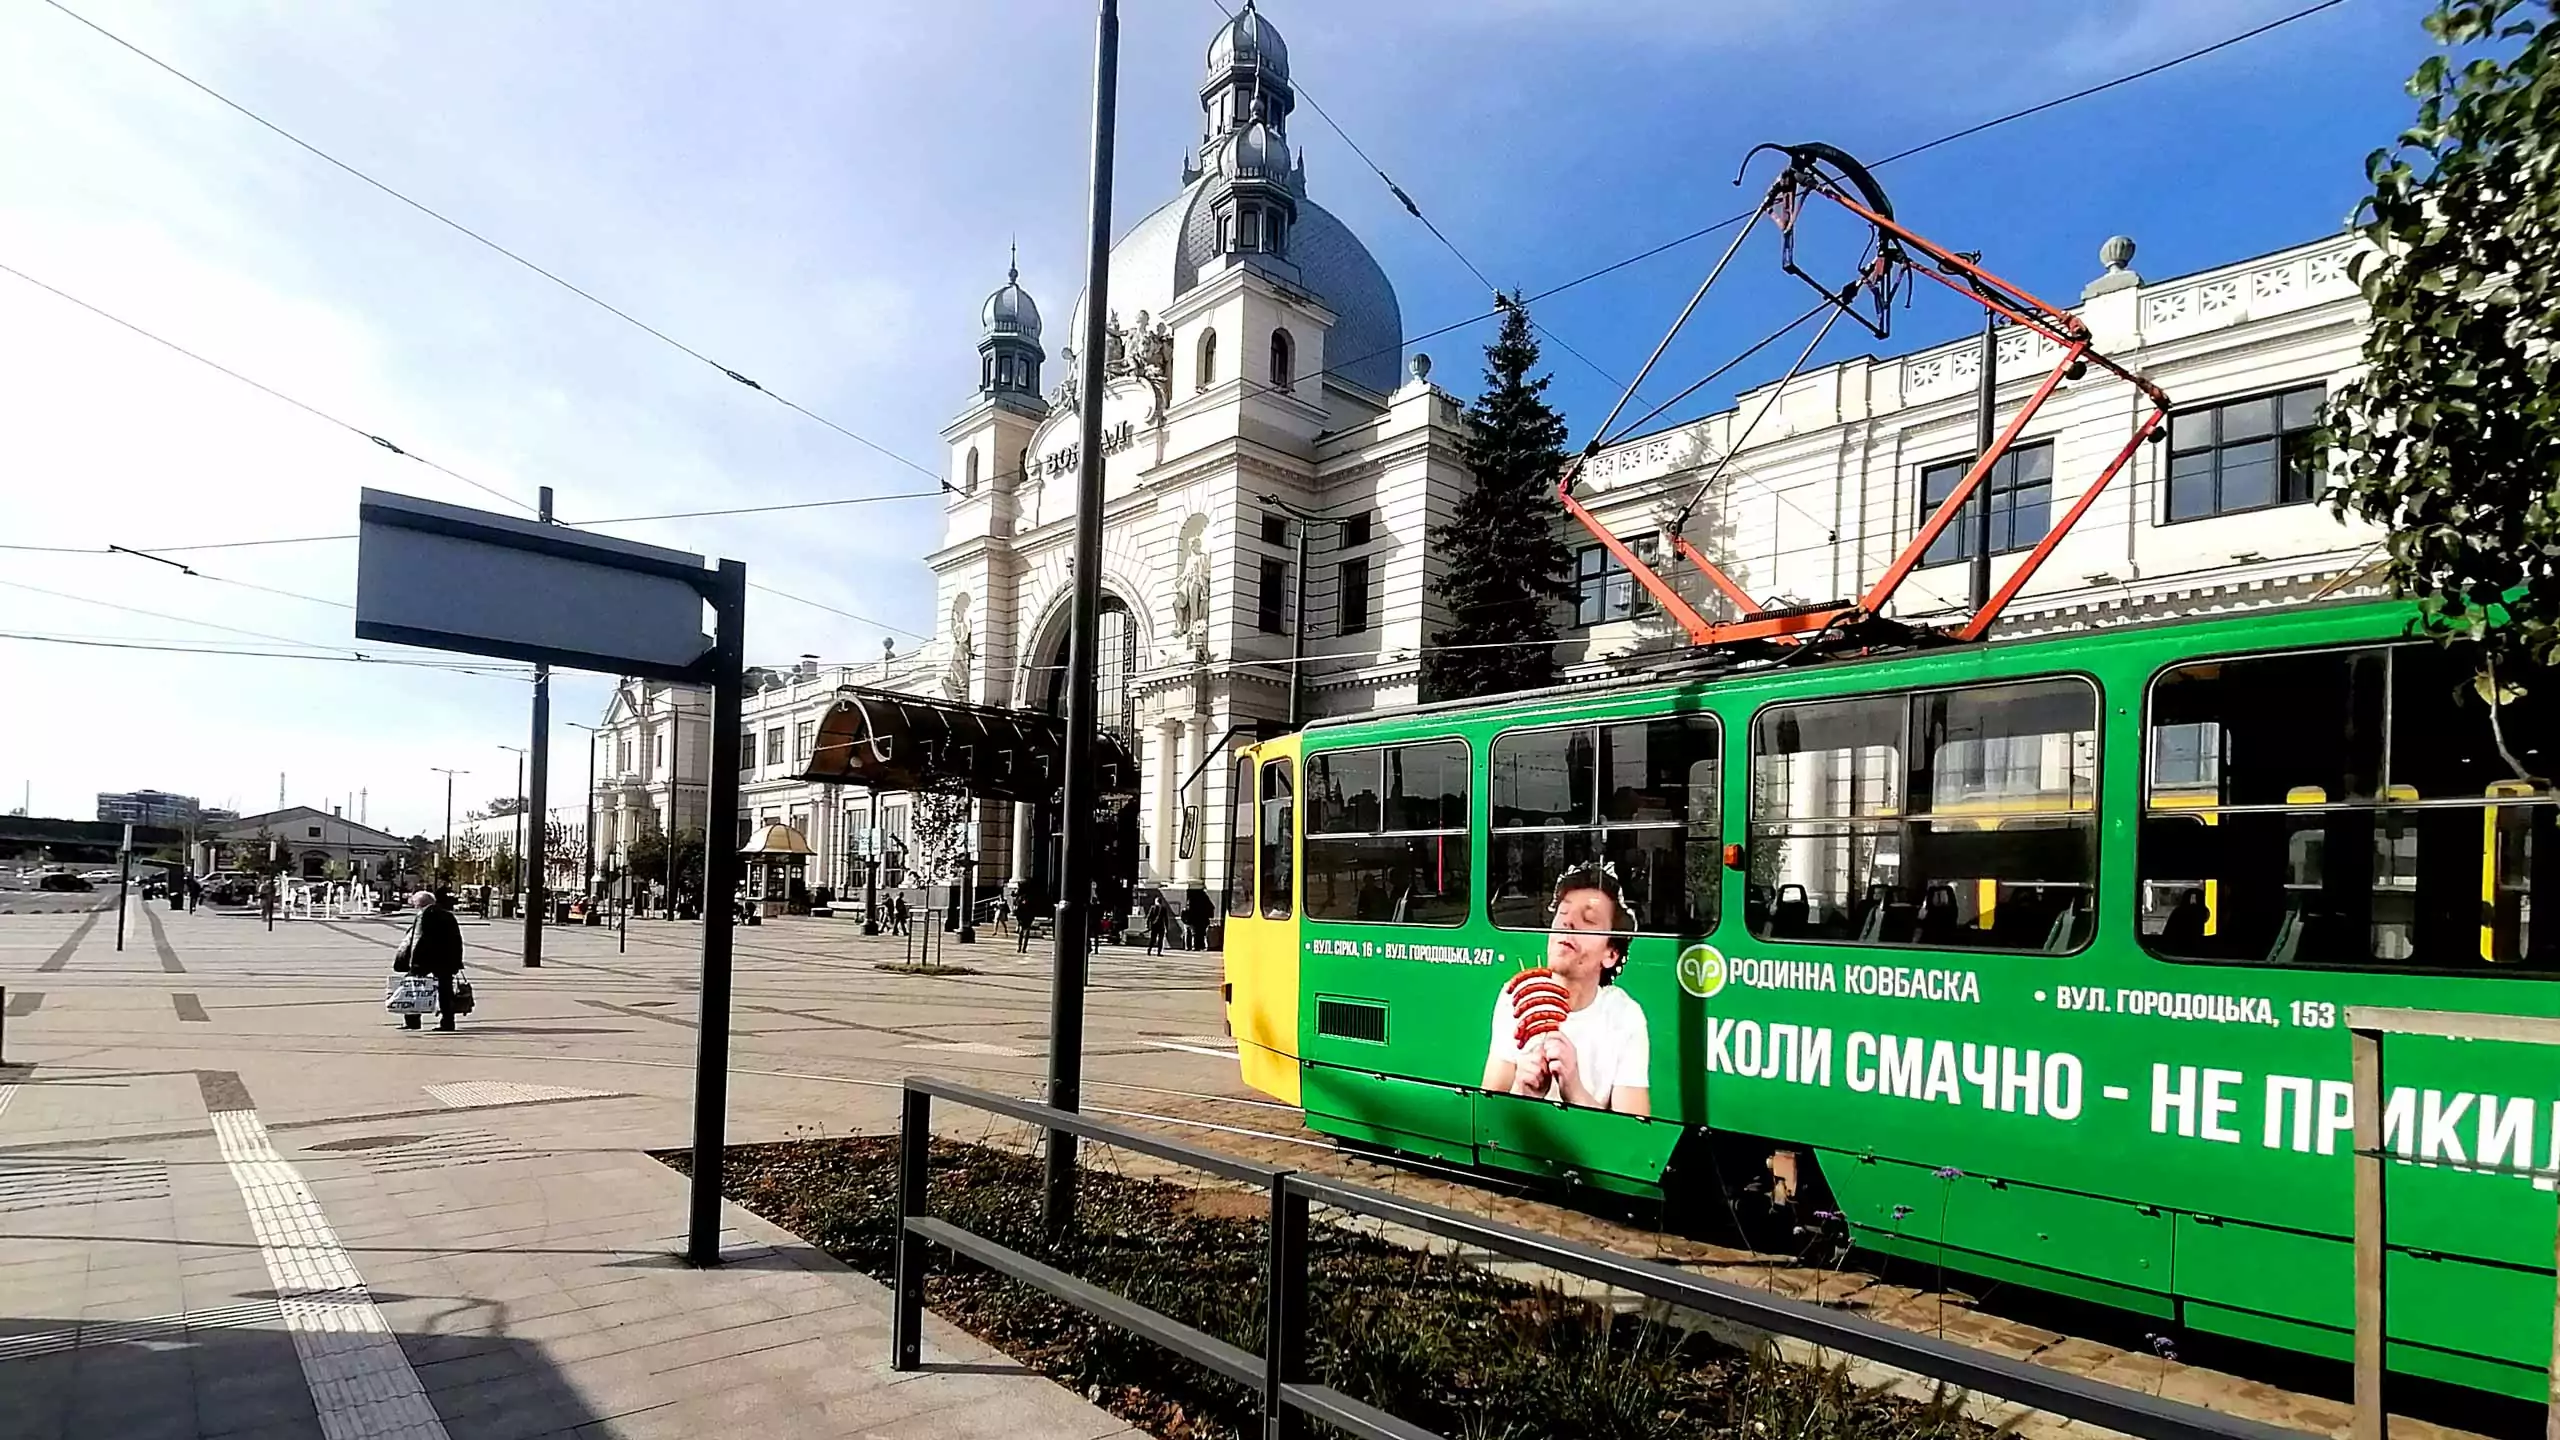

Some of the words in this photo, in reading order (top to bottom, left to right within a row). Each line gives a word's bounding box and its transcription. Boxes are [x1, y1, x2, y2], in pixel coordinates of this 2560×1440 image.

[1046, 420, 1129, 475] ВОАЛ
[1313, 939, 1333, 955] ВУЛ.
[1333, 940, 1360, 958] СІРКА,
[1362, 941, 1373, 957] 16
[1385, 943, 1408, 960] ВУЛ.
[1409, 944, 1472, 966] ГОРОДОЦЬКА,
[1473, 948, 1494, 965] 247
[1729, 957, 1836, 991] РОДИННА
[1844, 964, 1980, 1003] КОВБАСКА
[387, 1001, 415, 1009] CTION
[2057, 985, 2111, 1012] ВУЛ.
[2116, 989, 2280, 1027] ГОРОДОЦЬКА,
[2290, 1000, 2336, 1028] 153
[1706, 1016, 1832, 1087] КОЛИ
[1845, 1031, 2083, 1121] СМАЧНО
[2150, 1062, 2243, 1144] НЕ
